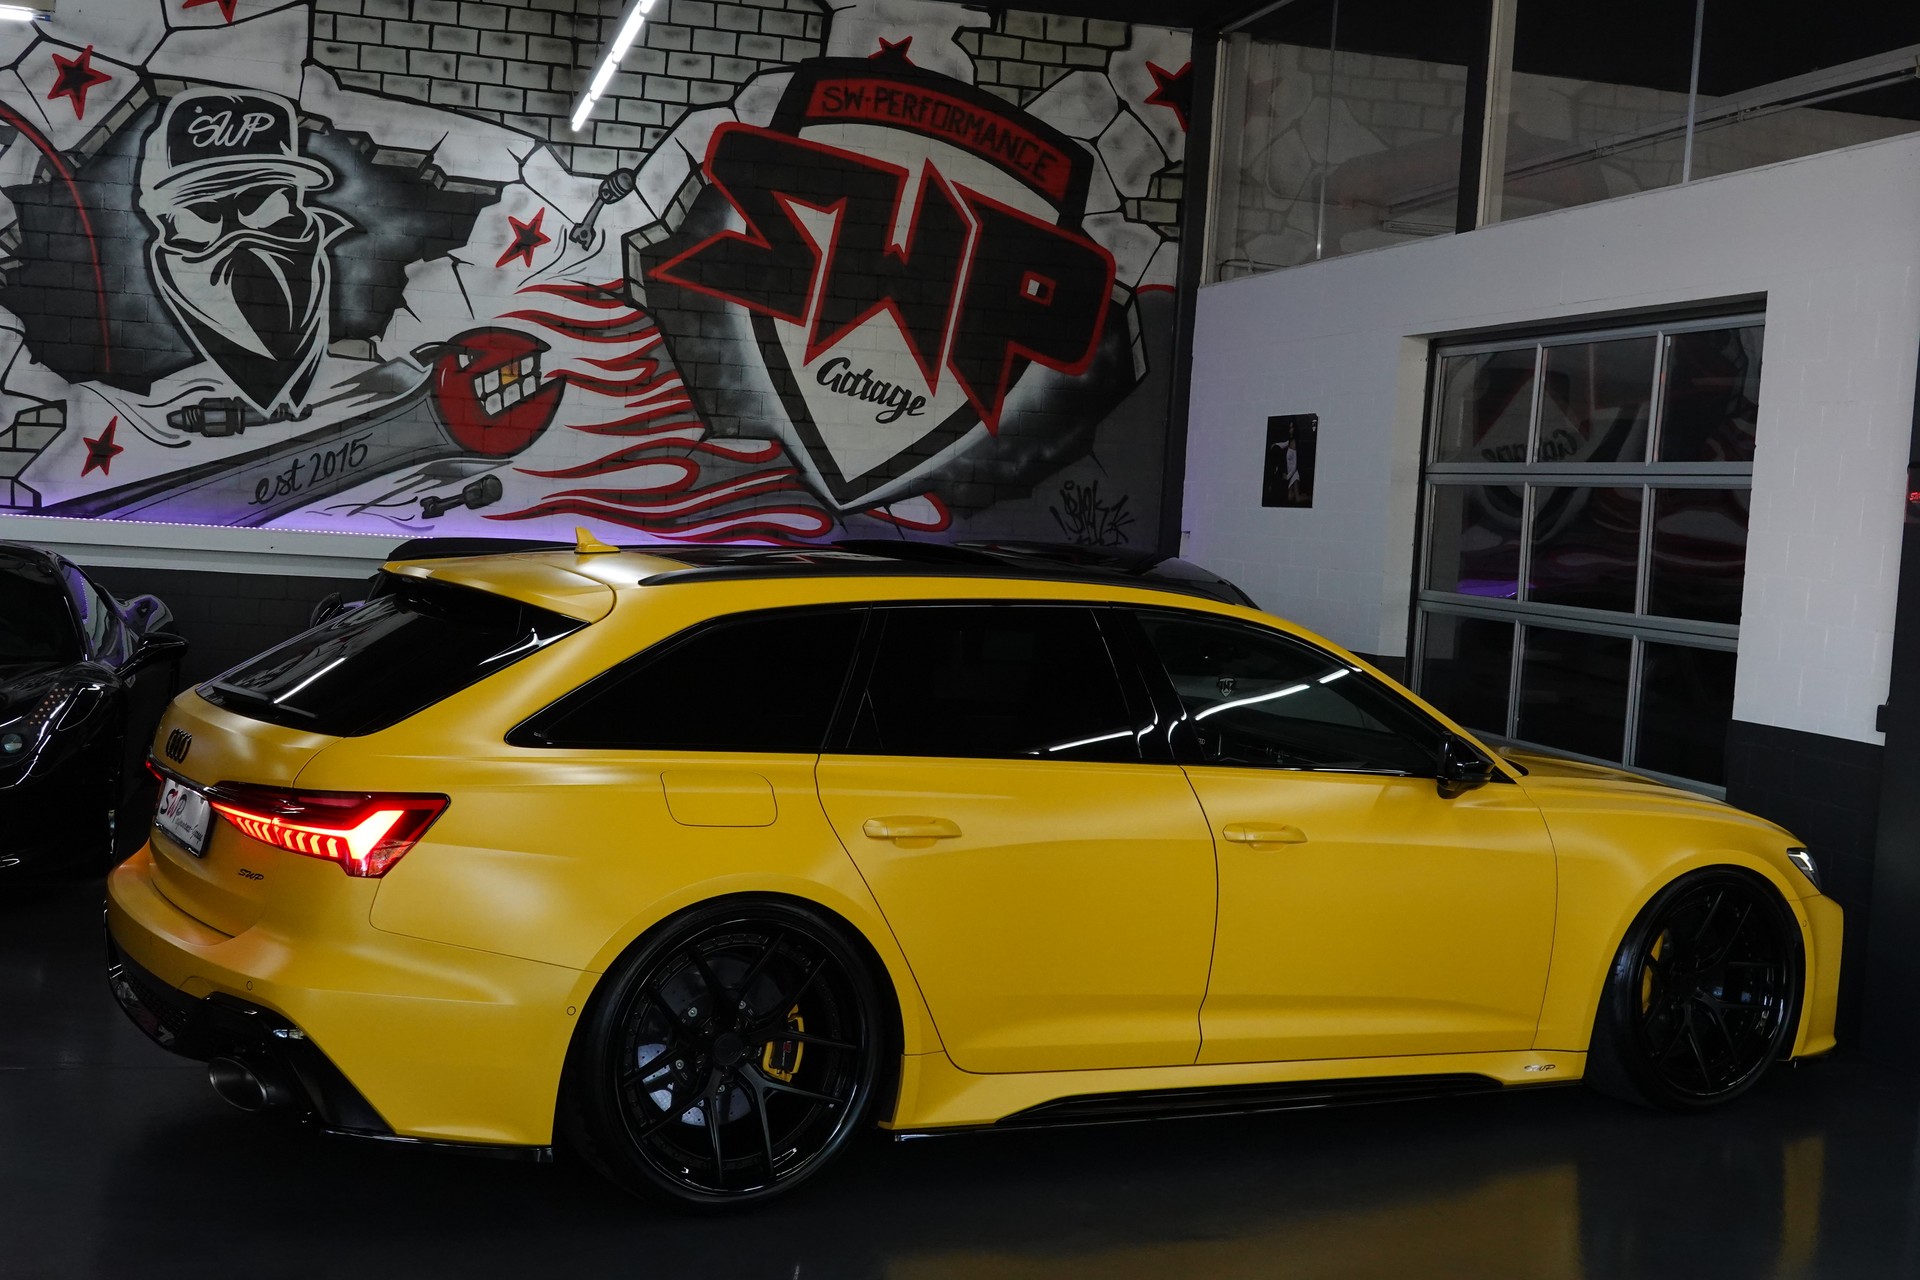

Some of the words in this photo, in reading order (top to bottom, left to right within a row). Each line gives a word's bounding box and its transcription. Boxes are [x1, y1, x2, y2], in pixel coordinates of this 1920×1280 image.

[187, 110, 276, 148] SWP
[648, 121, 1117, 438] SWP
[816, 356, 927, 424] Garage
[248, 458, 305, 505] est
[307, 432, 373, 488] 2015
[160, 788, 188, 823] SWP
[238, 868, 265, 881] SWP
